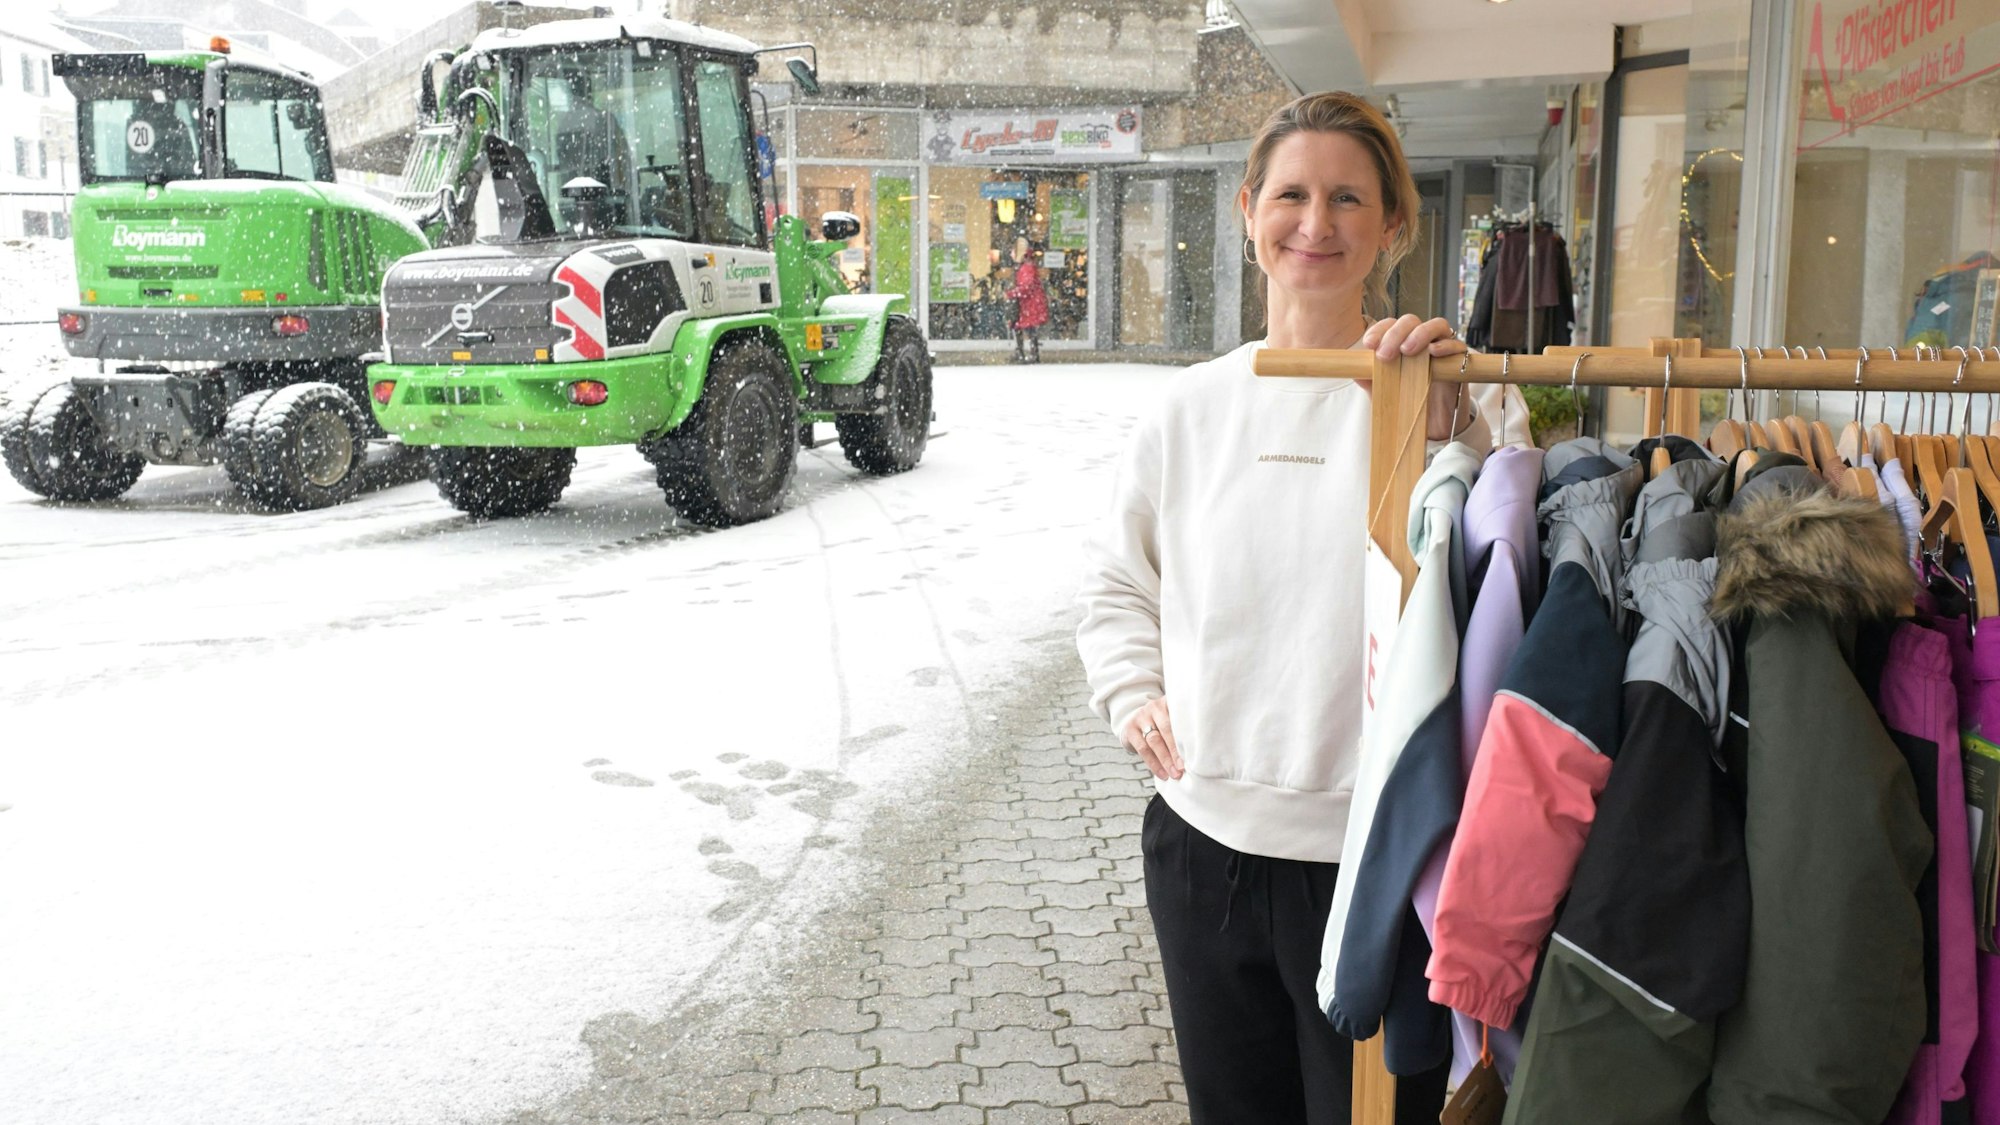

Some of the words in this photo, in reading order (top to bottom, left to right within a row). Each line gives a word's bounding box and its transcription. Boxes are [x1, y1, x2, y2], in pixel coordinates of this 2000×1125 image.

[1882, 79, 1898, 106] von
[1900, 55, 1925, 100] Kopf
[1925, 51, 1939, 87] bis
[1942, 35, 1966, 79] Fuß
[133, 126, 149, 147] 20
[112, 224, 206, 251] Boymann
[402, 263, 534, 282] www.boymann.de
[700, 280, 714, 304] 20
[1257, 454, 1326, 465] ARMEDANGELS
